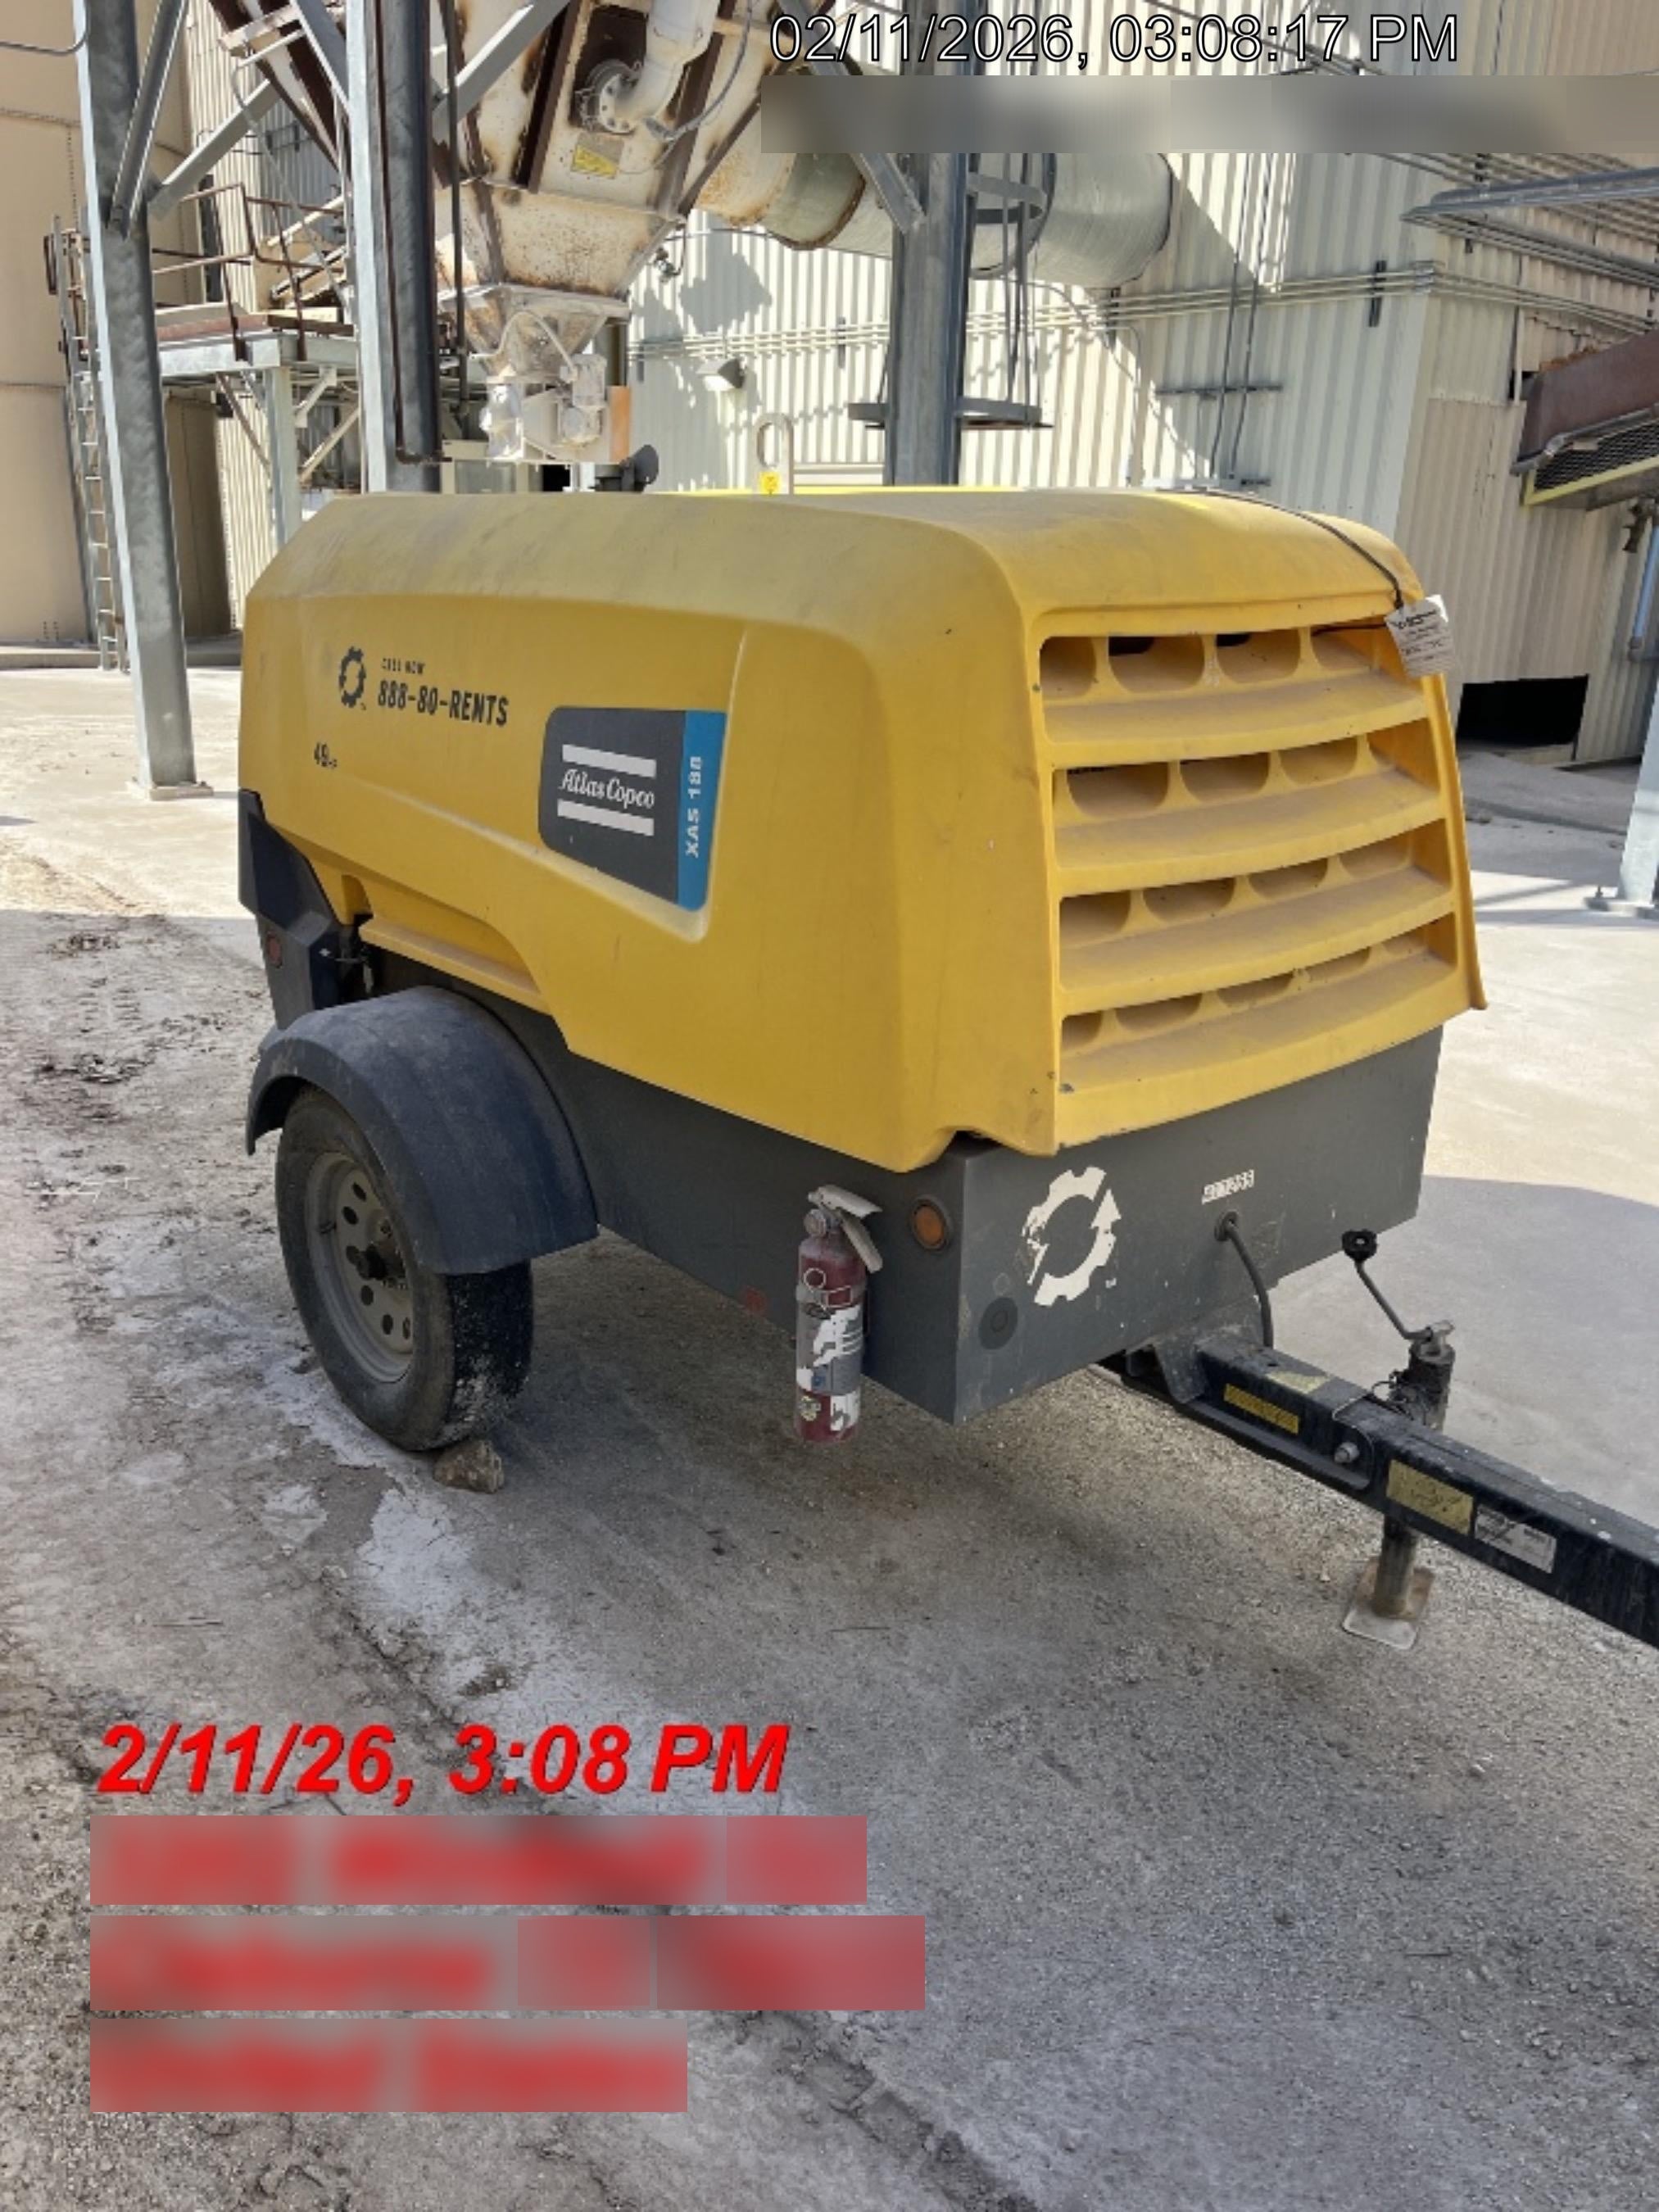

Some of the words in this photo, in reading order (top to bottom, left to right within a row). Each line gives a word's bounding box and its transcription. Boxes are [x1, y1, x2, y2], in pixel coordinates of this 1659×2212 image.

[378, 680, 509, 726] 888-80-RENTS
[558, 768, 605, 800] Atlas
[605, 776, 655, 809] Copco
[685, 807, 700, 859] XAS
